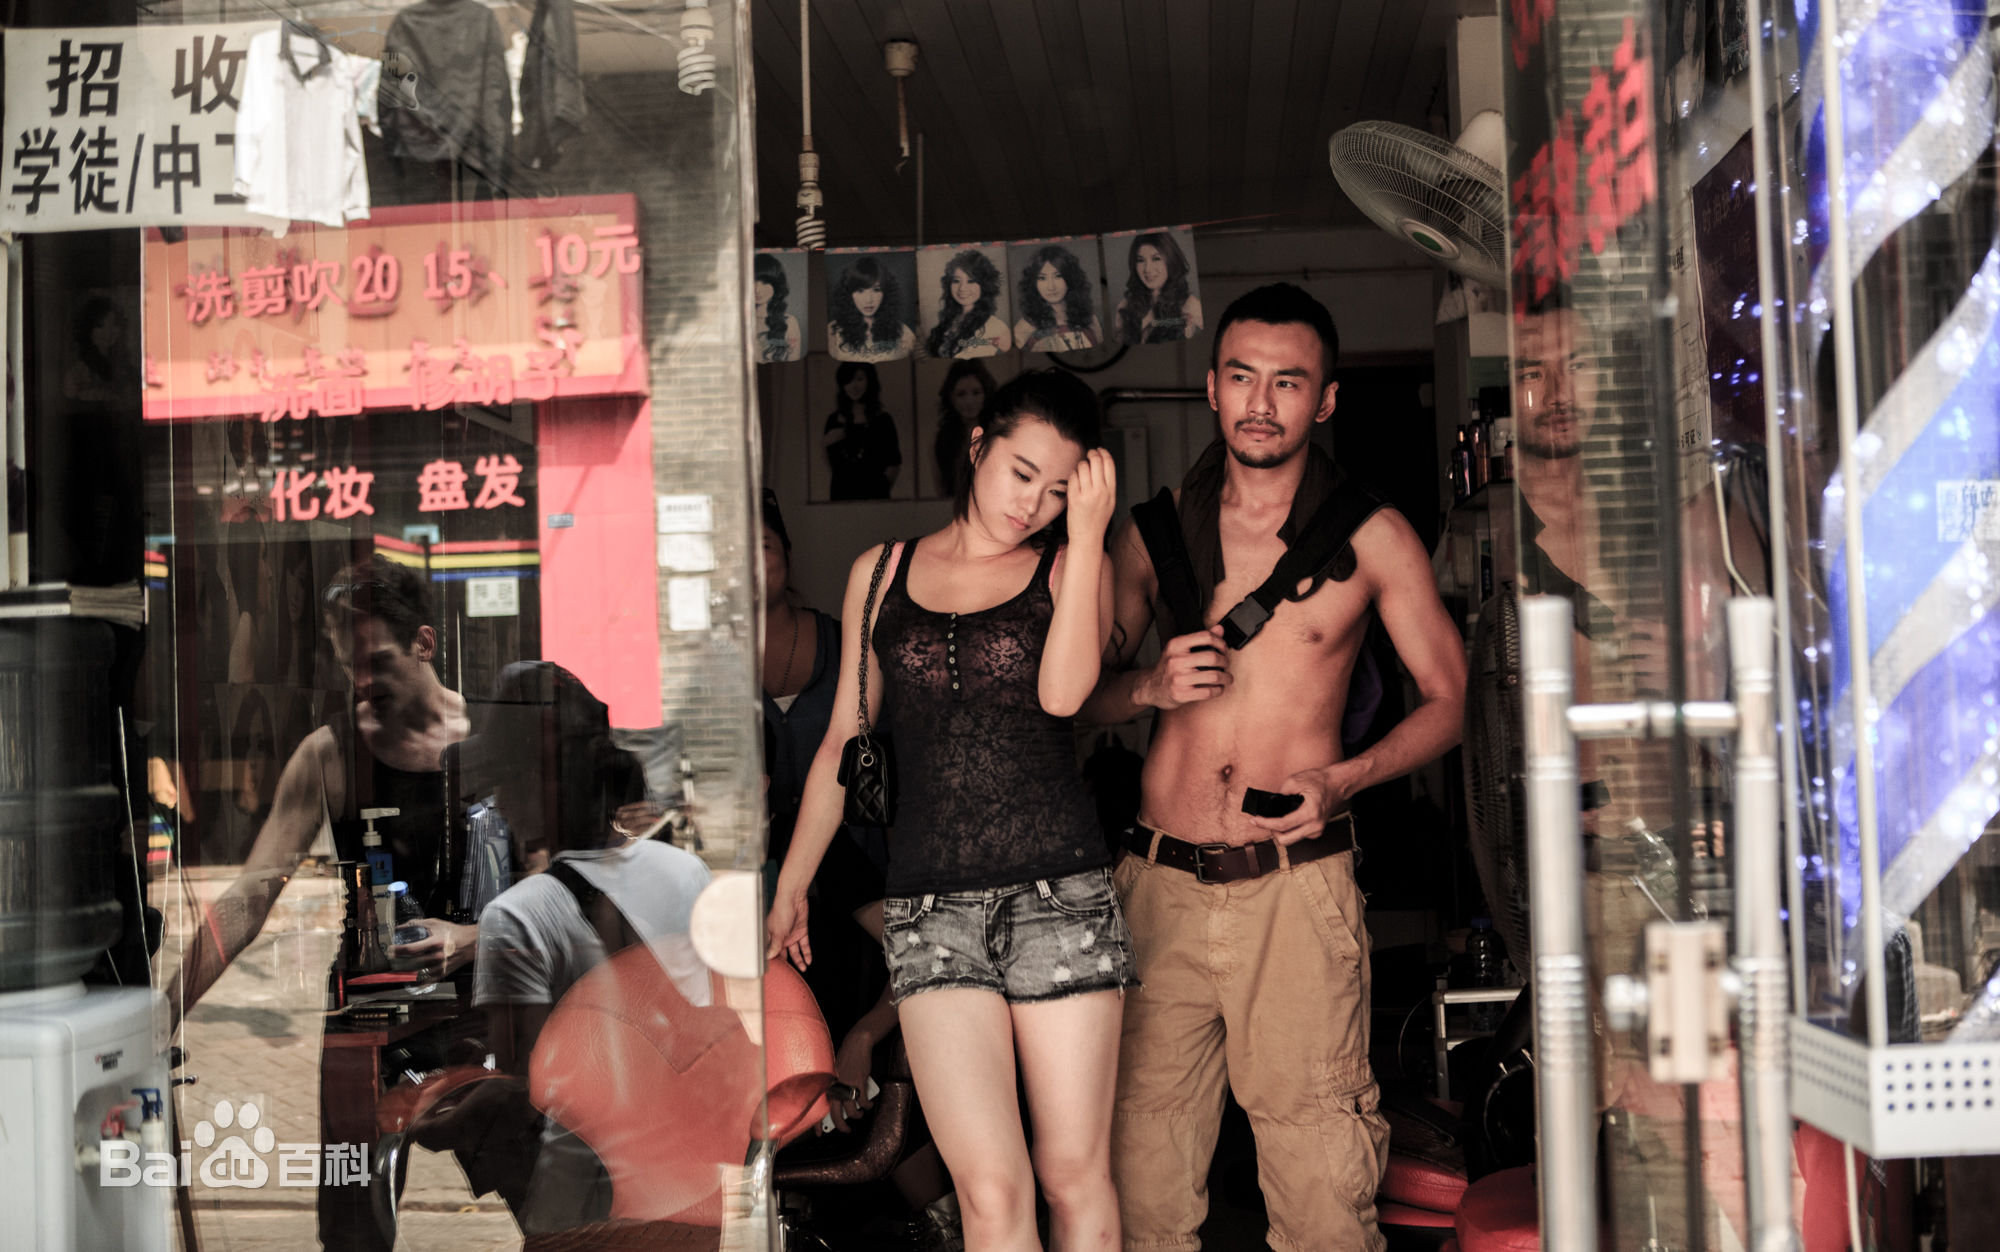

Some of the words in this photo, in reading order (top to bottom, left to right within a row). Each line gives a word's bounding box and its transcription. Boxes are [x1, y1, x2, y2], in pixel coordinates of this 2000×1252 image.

[186, 253, 398, 323] 洗剪吹20
[536, 224, 641, 278] 10元
[269, 466, 375, 522] 化妆
[417, 454, 526, 513] 盘发
